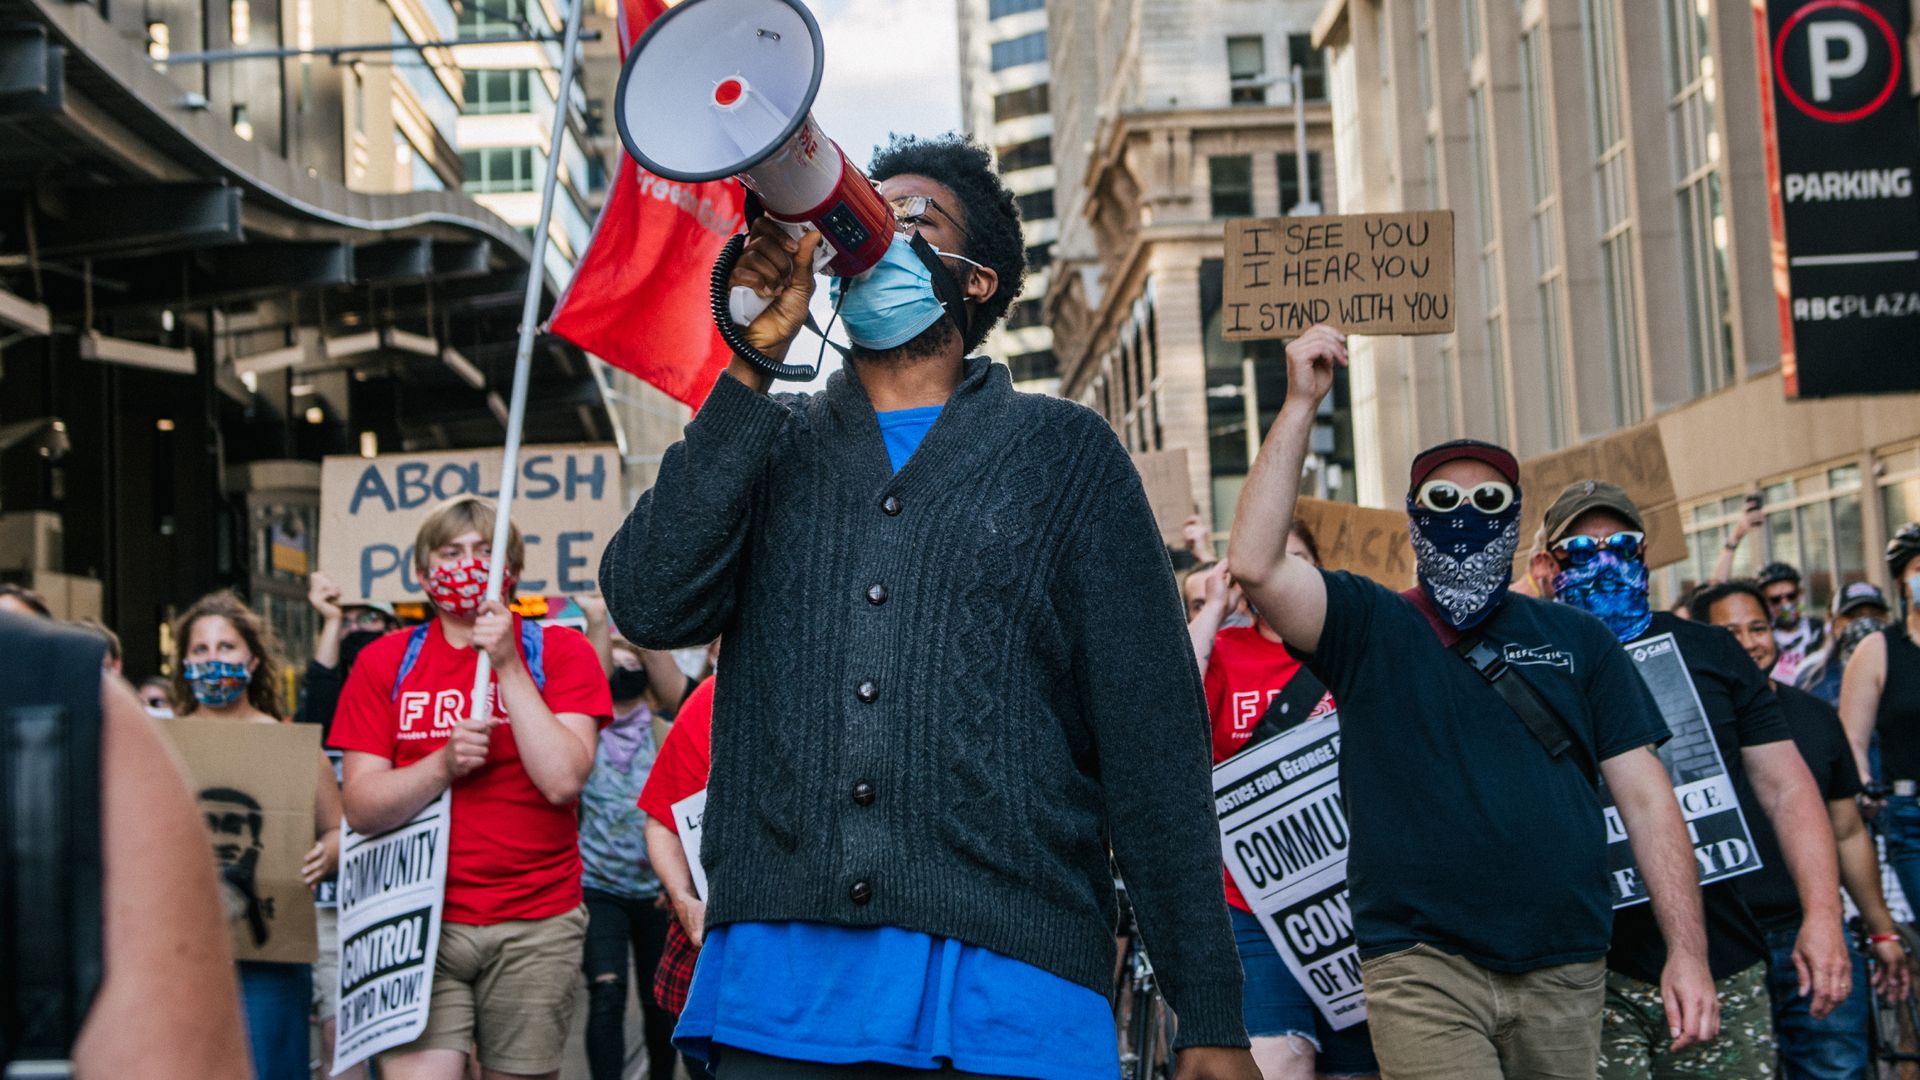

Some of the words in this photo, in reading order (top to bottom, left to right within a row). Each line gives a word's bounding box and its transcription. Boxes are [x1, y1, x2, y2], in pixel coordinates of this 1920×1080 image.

[1808, 20, 1868, 102] P
[1784, 168, 1912, 202] PARKING
[1243, 228, 1275, 257] I
[1285, 223, 1344, 255] SEE
[1364, 218, 1429, 250] YOU
[1243, 261, 1271, 289] I
[1283, 252, 1365, 287] HEAR
[1371, 254, 1430, 282] YOU
[1226, 303, 1253, 332] I
[1259, 298, 1330, 331] STAND
[1339, 293, 1394, 325] WITH
[1404, 291, 1449, 323] YOU
[349, 454, 606, 515] ABOLSH
[1216, 782, 1260, 816] USTICE
[1253, 769, 1283, 794] FOR
[1278, 743, 1335, 781] GEORGE
[342, 827, 439, 911] COMMUNITY
[343, 914, 423, 989] CONTROL
[380, 971, 424, 1013] NOW!
[1308, 962, 1343, 997] OF
